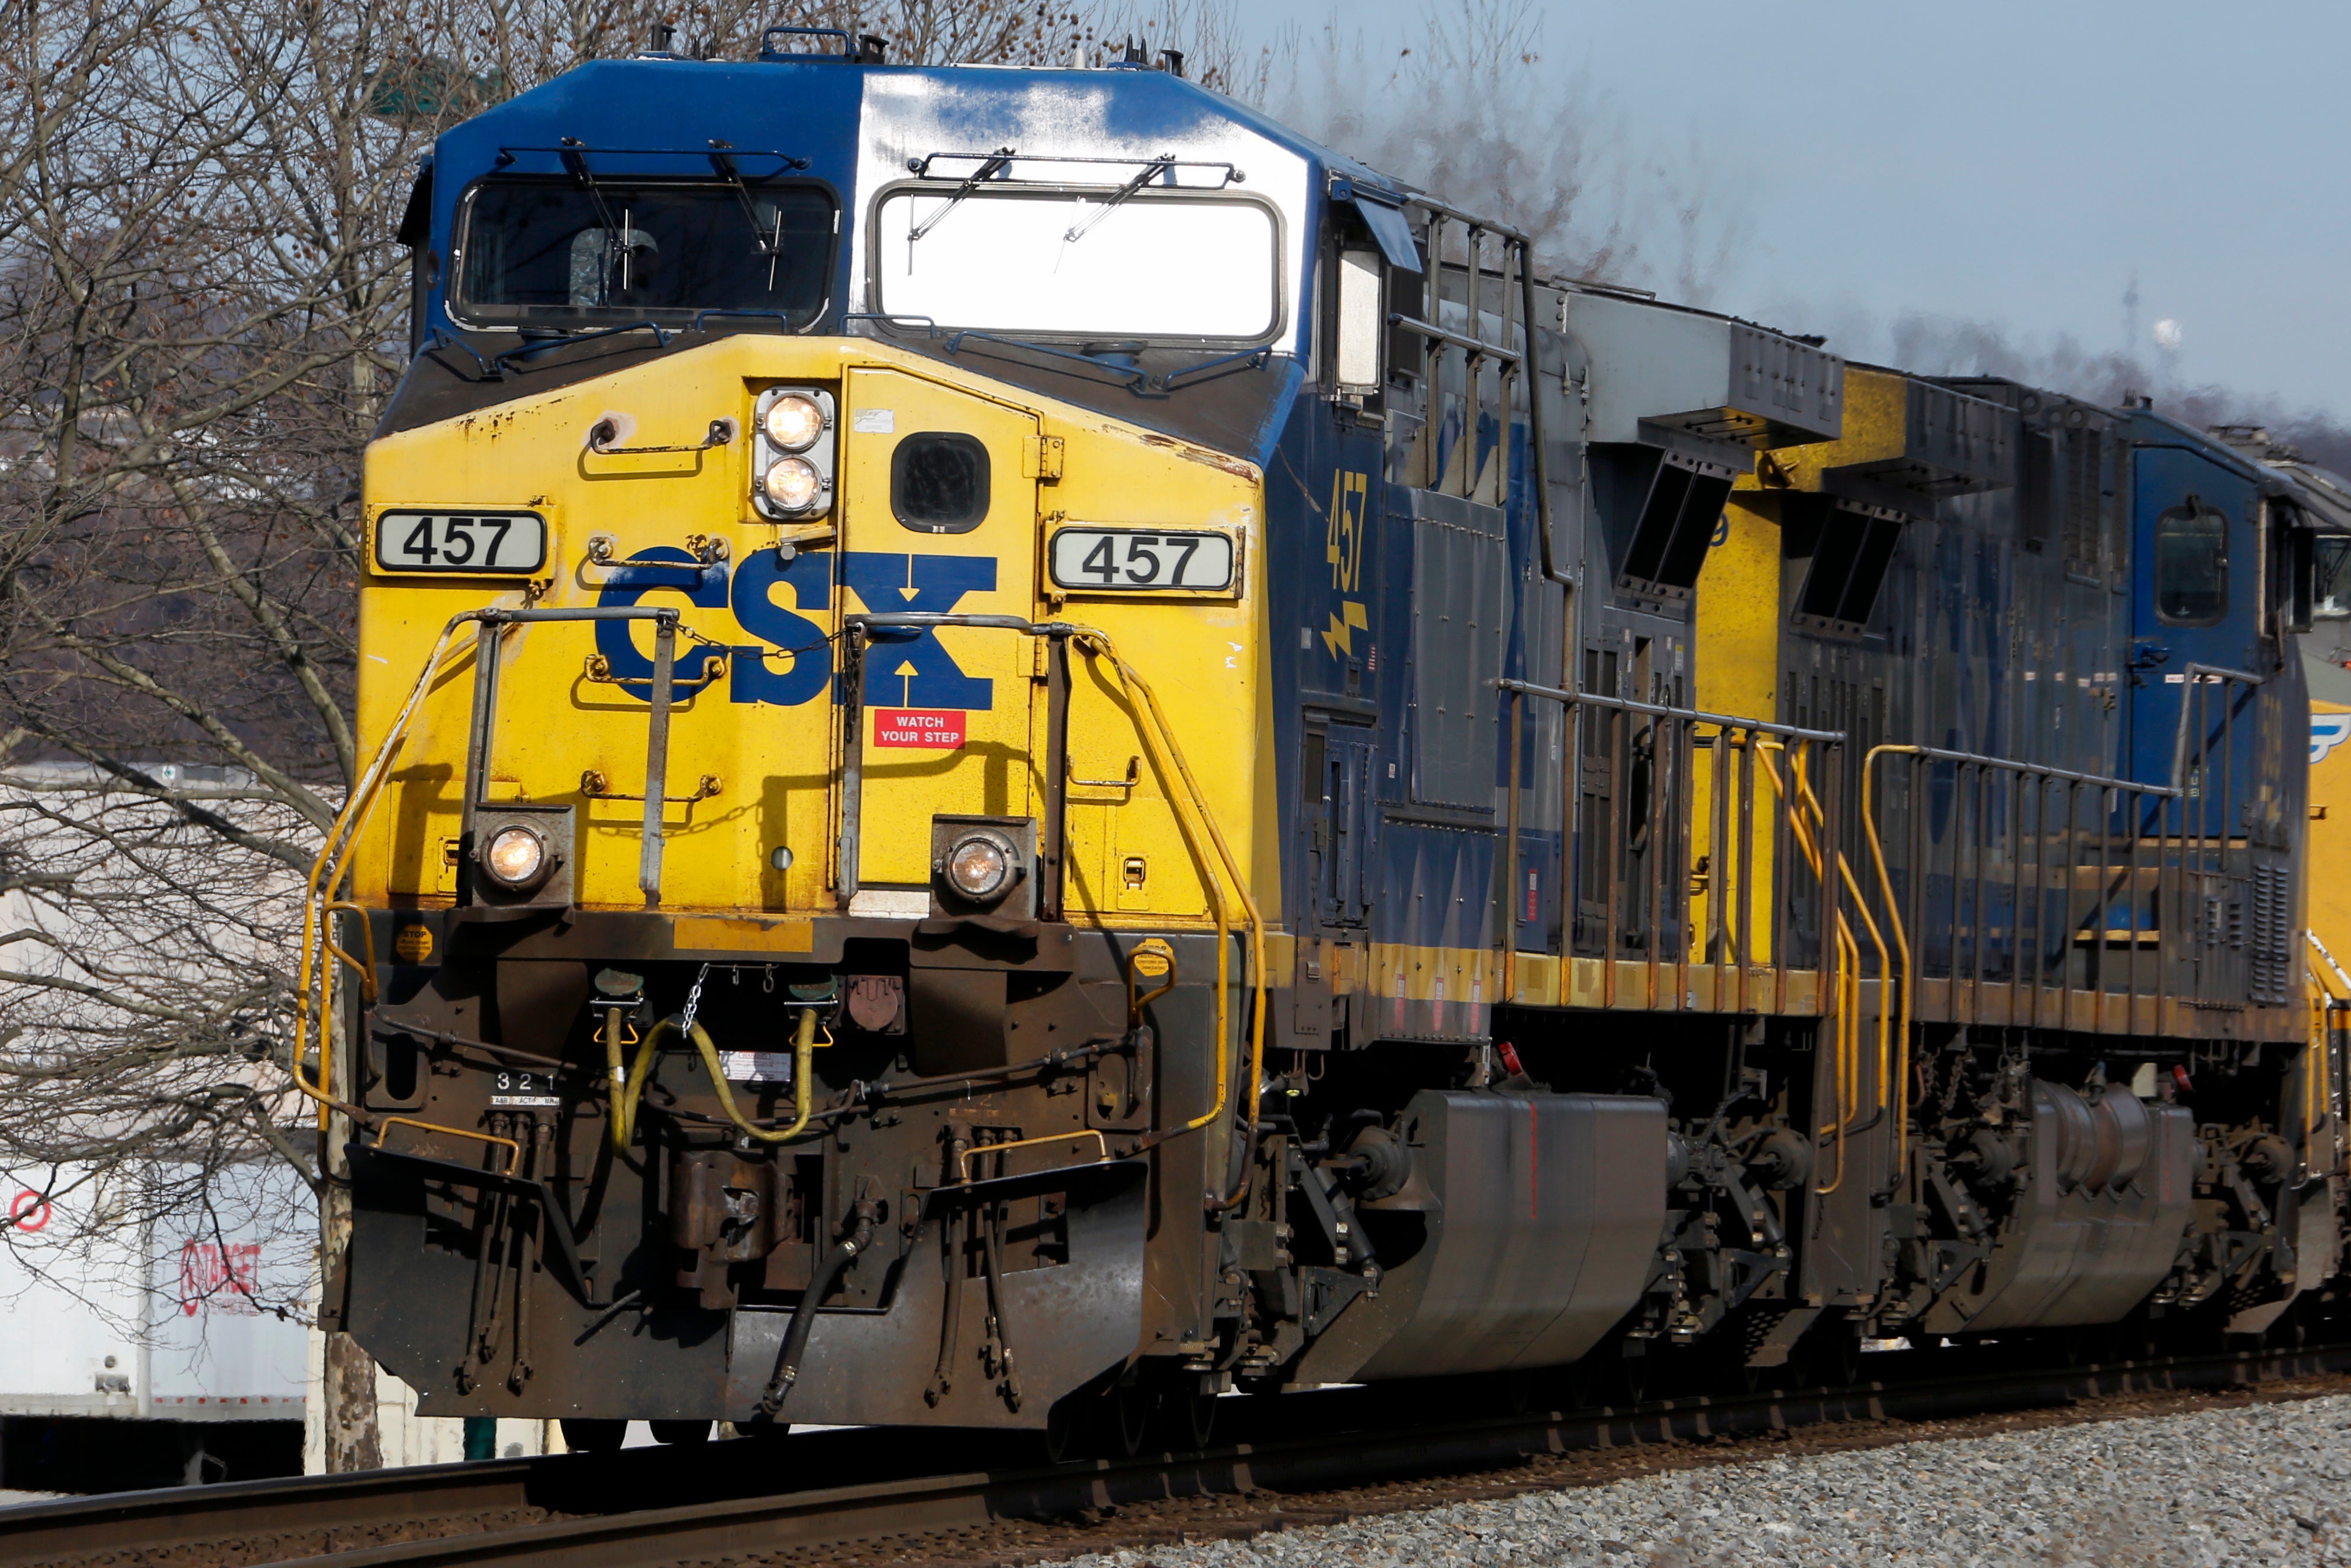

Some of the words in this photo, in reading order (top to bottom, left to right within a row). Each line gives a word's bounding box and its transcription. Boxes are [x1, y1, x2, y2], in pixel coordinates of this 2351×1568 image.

[403, 517, 511, 566] 457
[1327, 468, 1368, 592] 457
[1082, 536, 1199, 585] 457
[596, 546, 997, 710] CSX
[881, 731, 918, 741] YOUR
[924, 732, 959, 743] STEP
[896, 716, 944, 727] WATCH
[498, 1073, 509, 1089] 3
[520, 1074, 531, 1090] 2
[548, 1074, 554, 1090] 1
